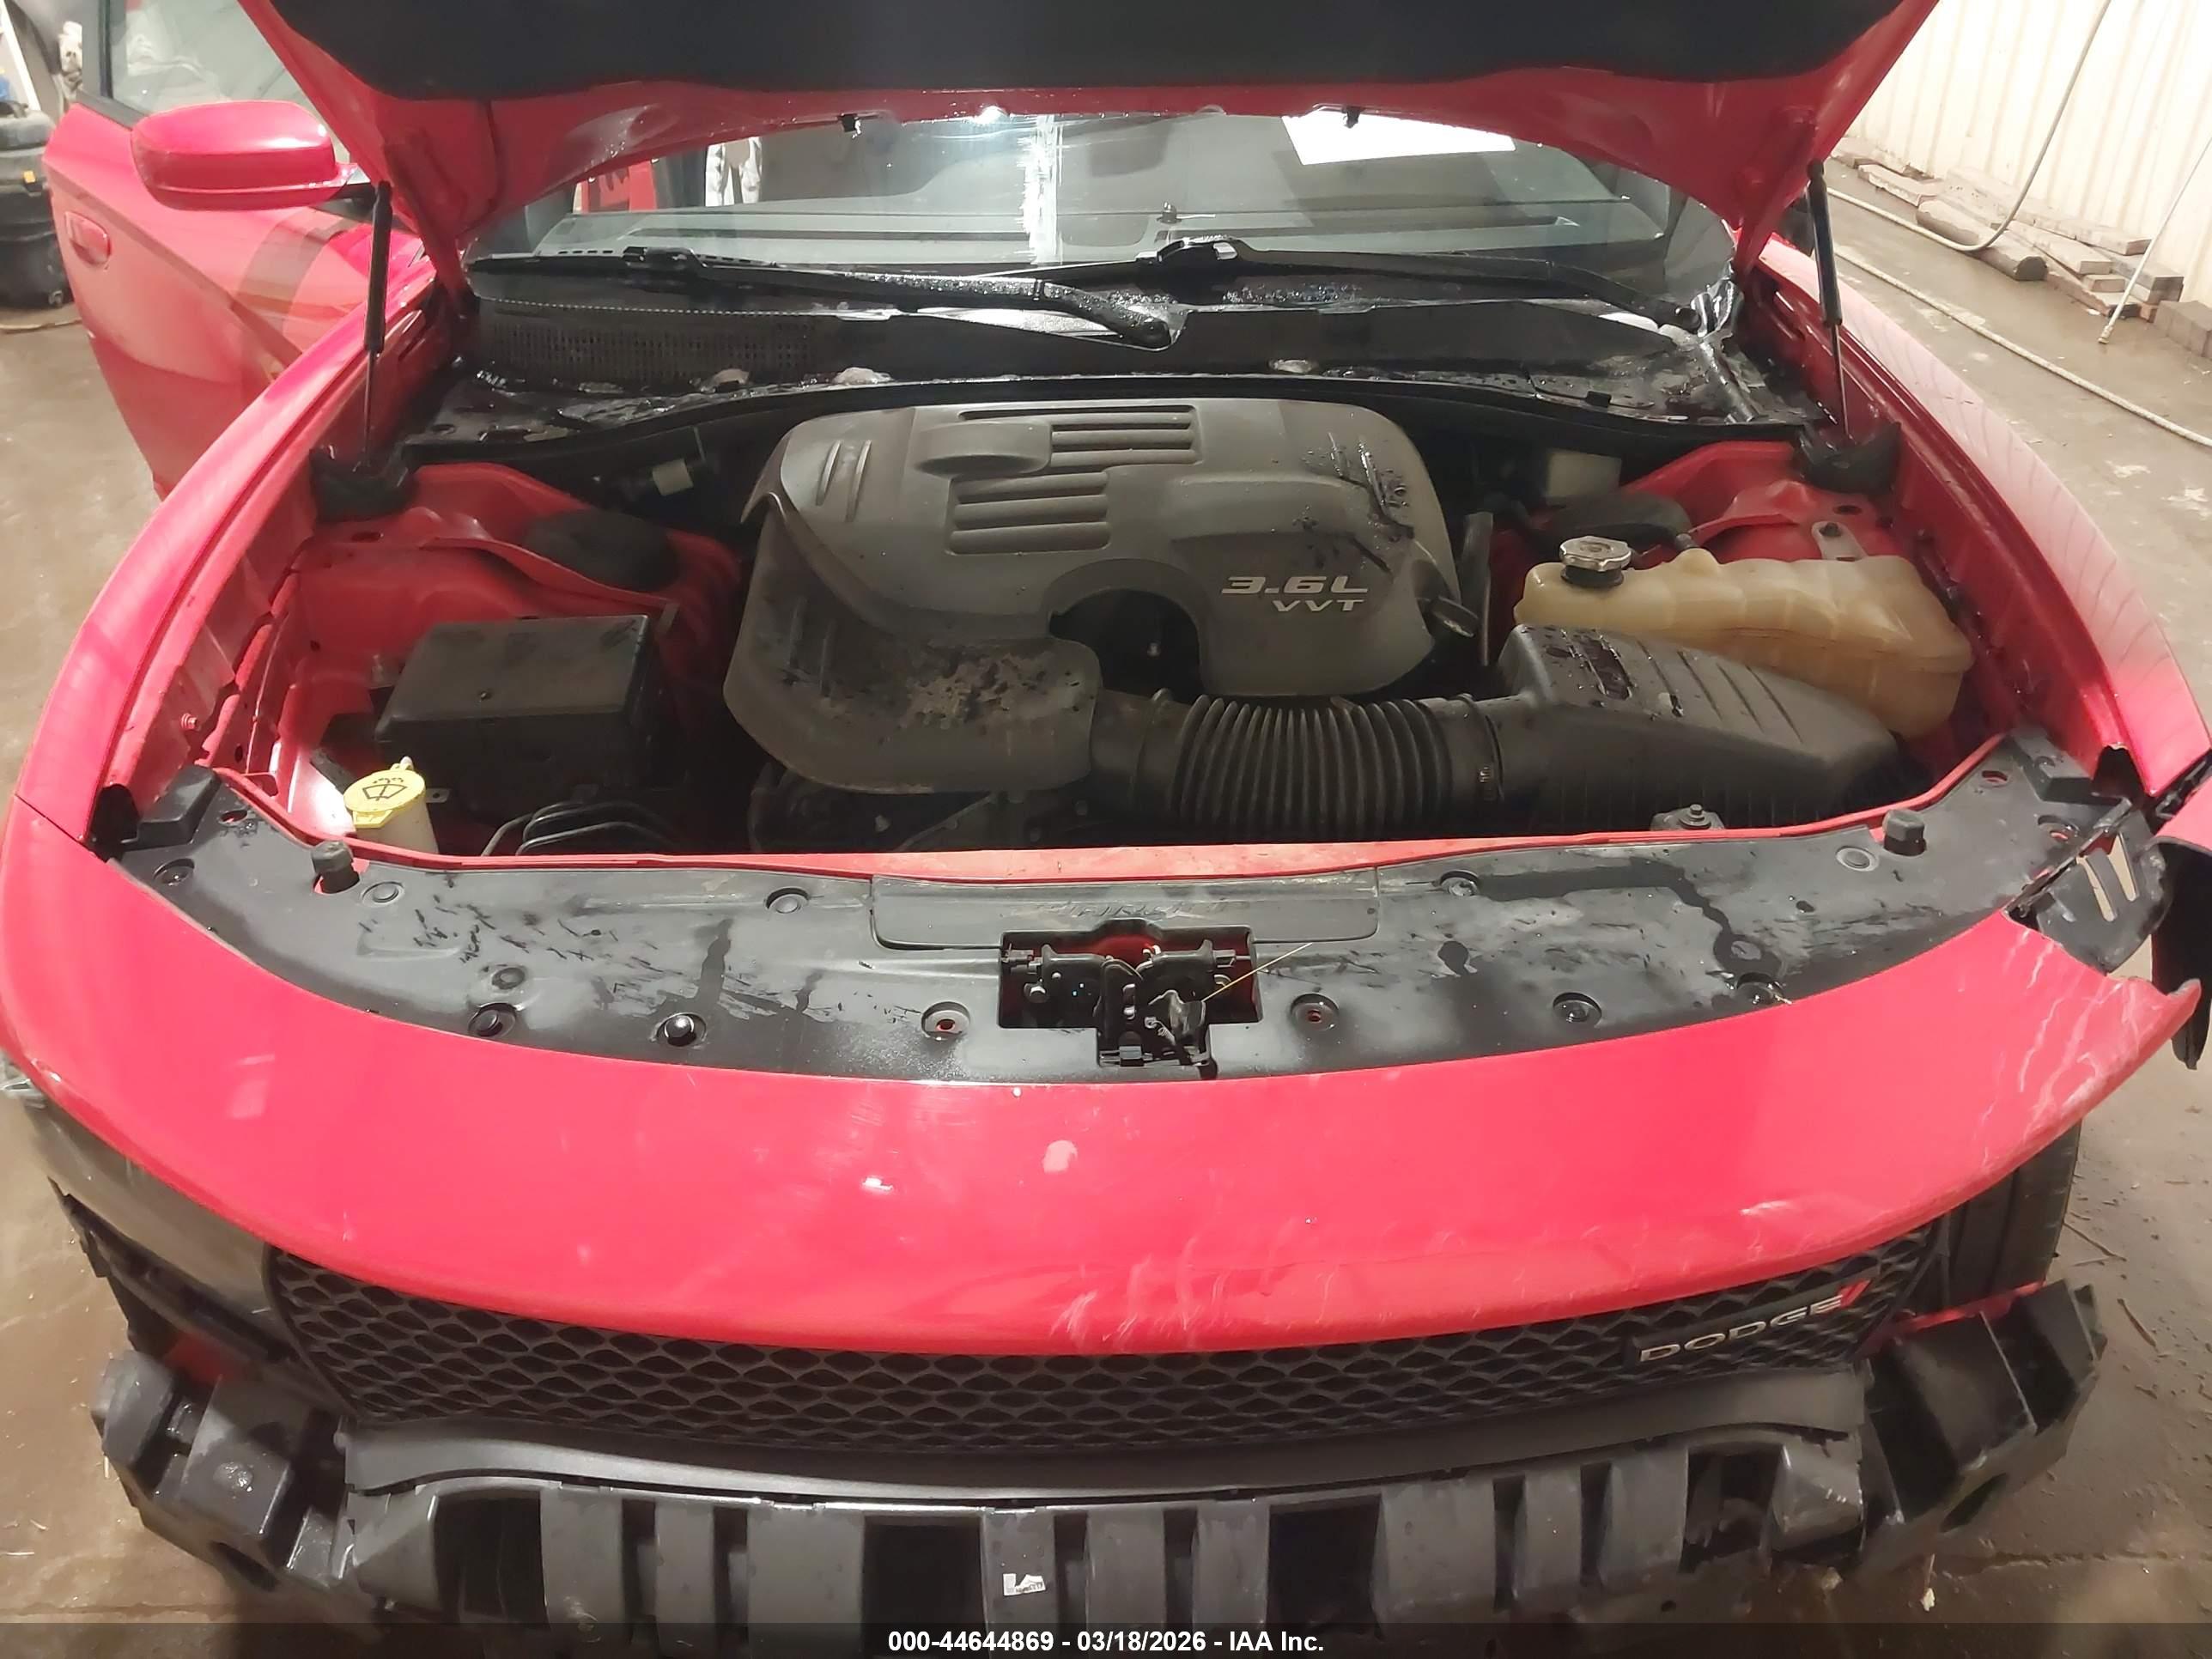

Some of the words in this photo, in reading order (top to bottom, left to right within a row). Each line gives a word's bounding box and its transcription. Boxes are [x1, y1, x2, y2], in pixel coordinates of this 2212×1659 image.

[1221, 575, 1368, 594] 3.6L
[1272, 599, 1364, 612] VVT
[1640, 1294, 1843, 1362] DODGE
